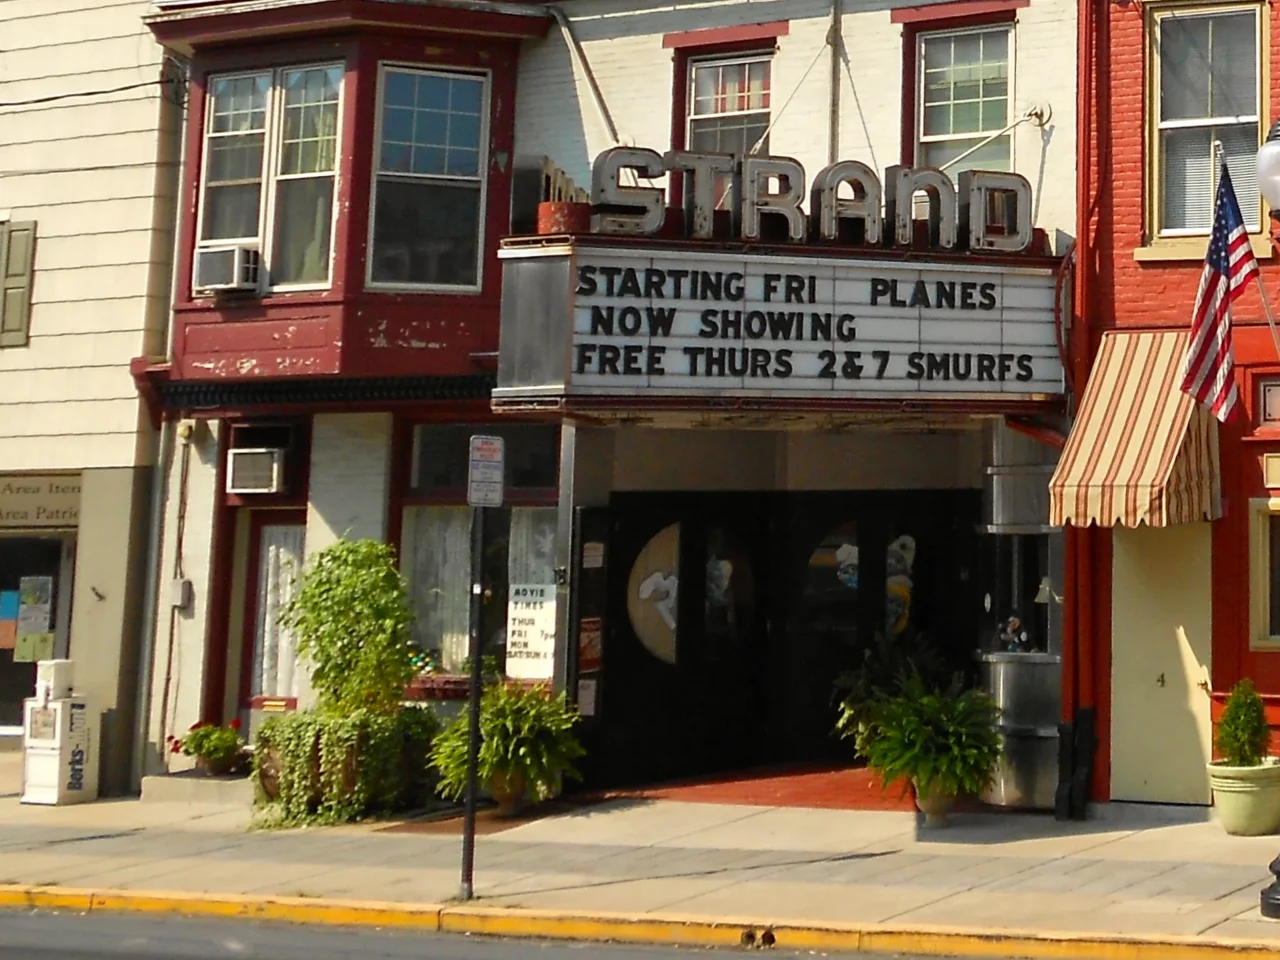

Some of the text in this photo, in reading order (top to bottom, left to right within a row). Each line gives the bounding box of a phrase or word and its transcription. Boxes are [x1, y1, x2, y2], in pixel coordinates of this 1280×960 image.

[576, 265, 997, 310] STARTING FRI PLANES
[590, 306, 857, 341] NOW SHOWING
[577, 344, 666, 376] FREE
[683, 346, 794, 378] THURS
[906, 351, 1034, 382] SMURFS
[2, 482, 40, 495] Area
[513, 588, 545, 598] MOVIE
[513, 601, 544, 611] TIMES
[511, 617, 536, 626] THUR
[511, 630, 528, 639] FRI
[510, 641, 529, 649] MON
[1156, 672, 1166, 688] 4
